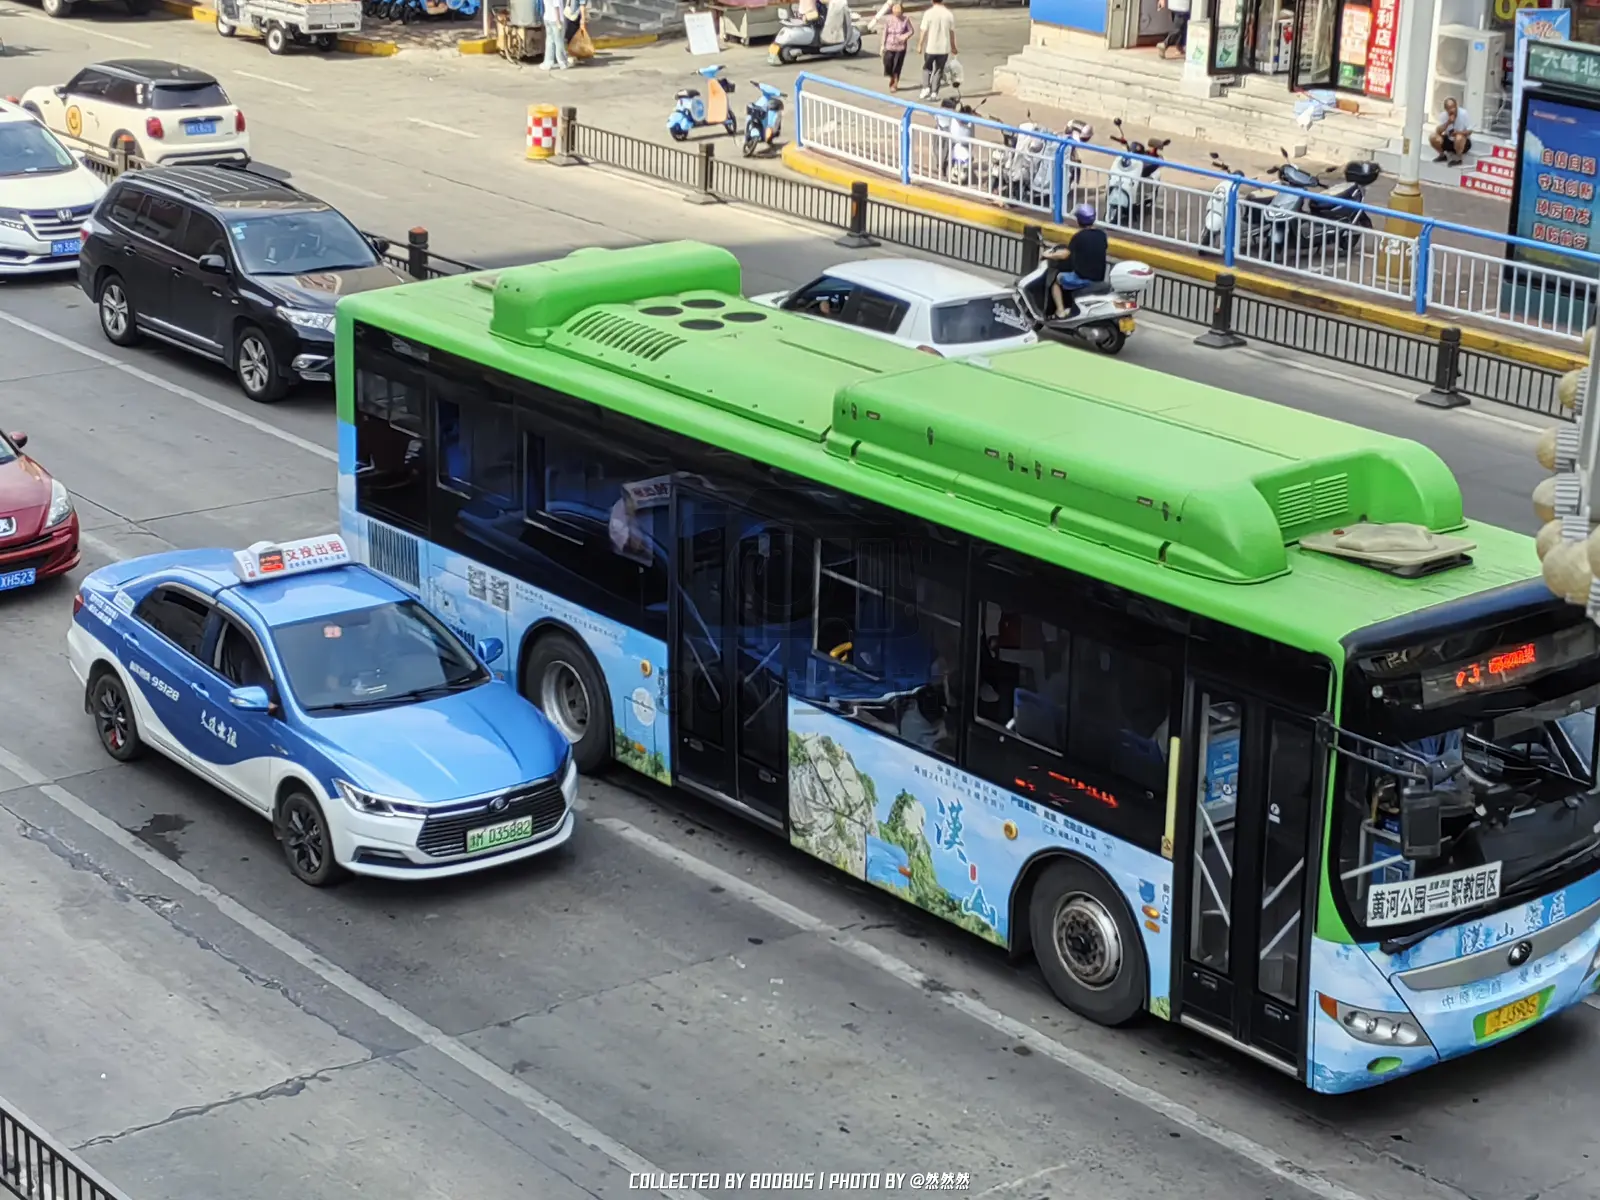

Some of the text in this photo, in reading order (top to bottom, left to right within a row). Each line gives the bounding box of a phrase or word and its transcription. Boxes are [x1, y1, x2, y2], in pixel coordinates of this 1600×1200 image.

[151, 676, 180, 702] 95128
[1371, 869, 1498, 920] 黄河公园 职教园区
